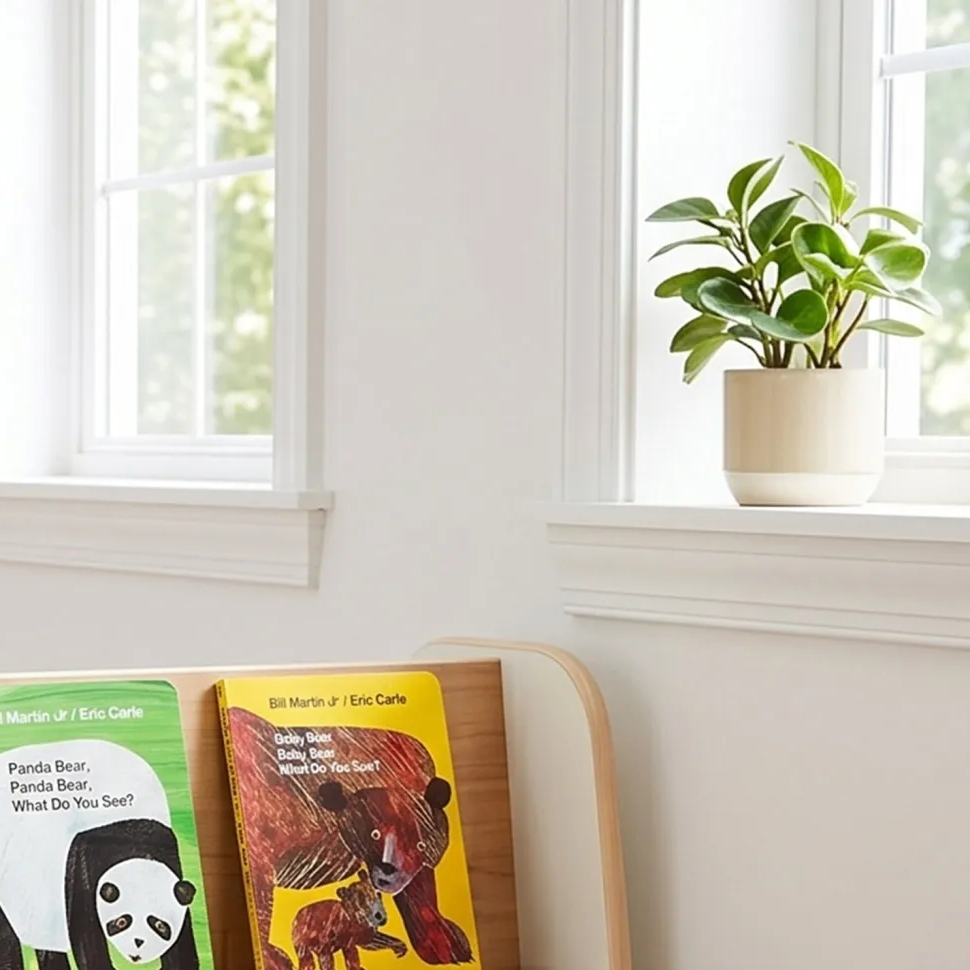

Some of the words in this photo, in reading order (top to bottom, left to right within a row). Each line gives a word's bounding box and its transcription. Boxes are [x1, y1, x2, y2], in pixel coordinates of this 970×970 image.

[269, 697, 287, 709] Bill
[289, 697, 324, 708] Martin
[350, 694, 373, 706] Eric
[6, 710, 50, 724] Martin
[54, 710, 67, 722] Jr
[8, 761, 52, 775] Panda
[55, 759, 91, 773] Bear,
[10, 780, 54, 794] Panda
[57, 778, 93, 792] Bear,
[12, 799, 48, 812] What
[51, 797, 70, 811] Do
[73, 796, 98, 809] You
[102, 793, 134, 808] See?
